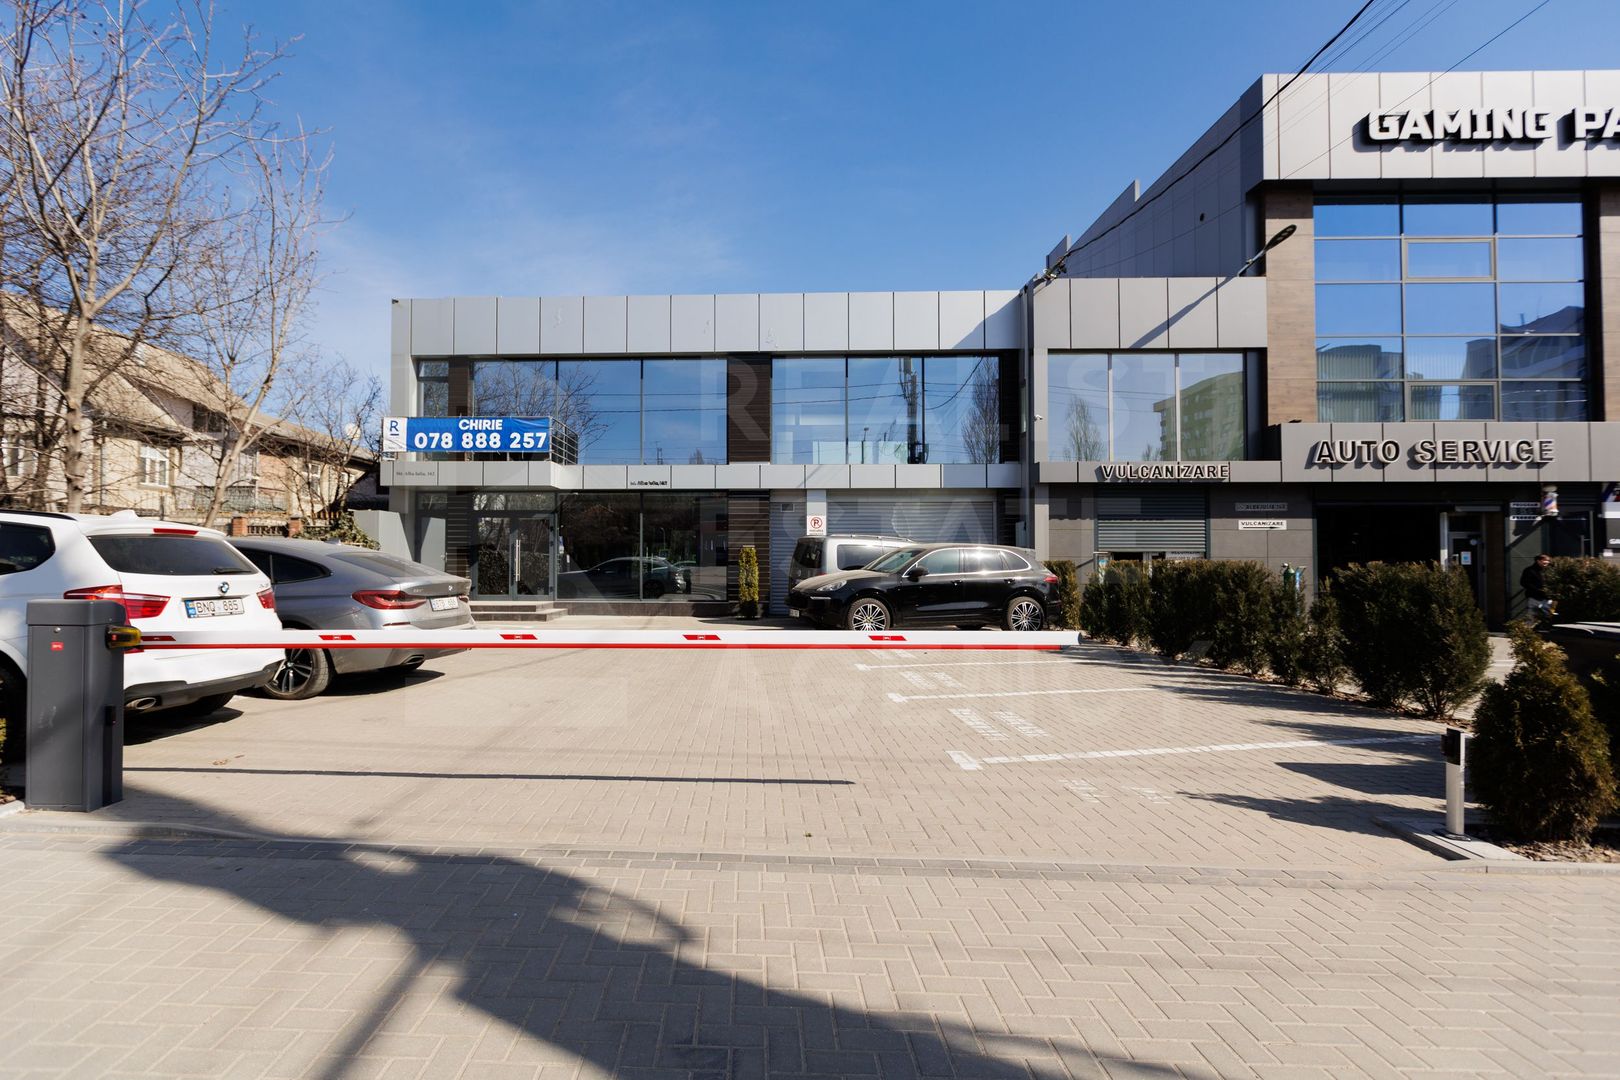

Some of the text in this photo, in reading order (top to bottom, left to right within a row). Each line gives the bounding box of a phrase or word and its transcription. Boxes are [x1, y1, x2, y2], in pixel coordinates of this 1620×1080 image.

[1368, 106, 1553, 140] GAMING
[389, 420, 399, 432] R
[458, 419, 503, 431] CHIRIE
[414, 432, 547, 449] 078 888 257
[1314, 439, 1555, 463] AUTO SERVICE
[1101, 463, 1229, 479] VULCANIZARE
